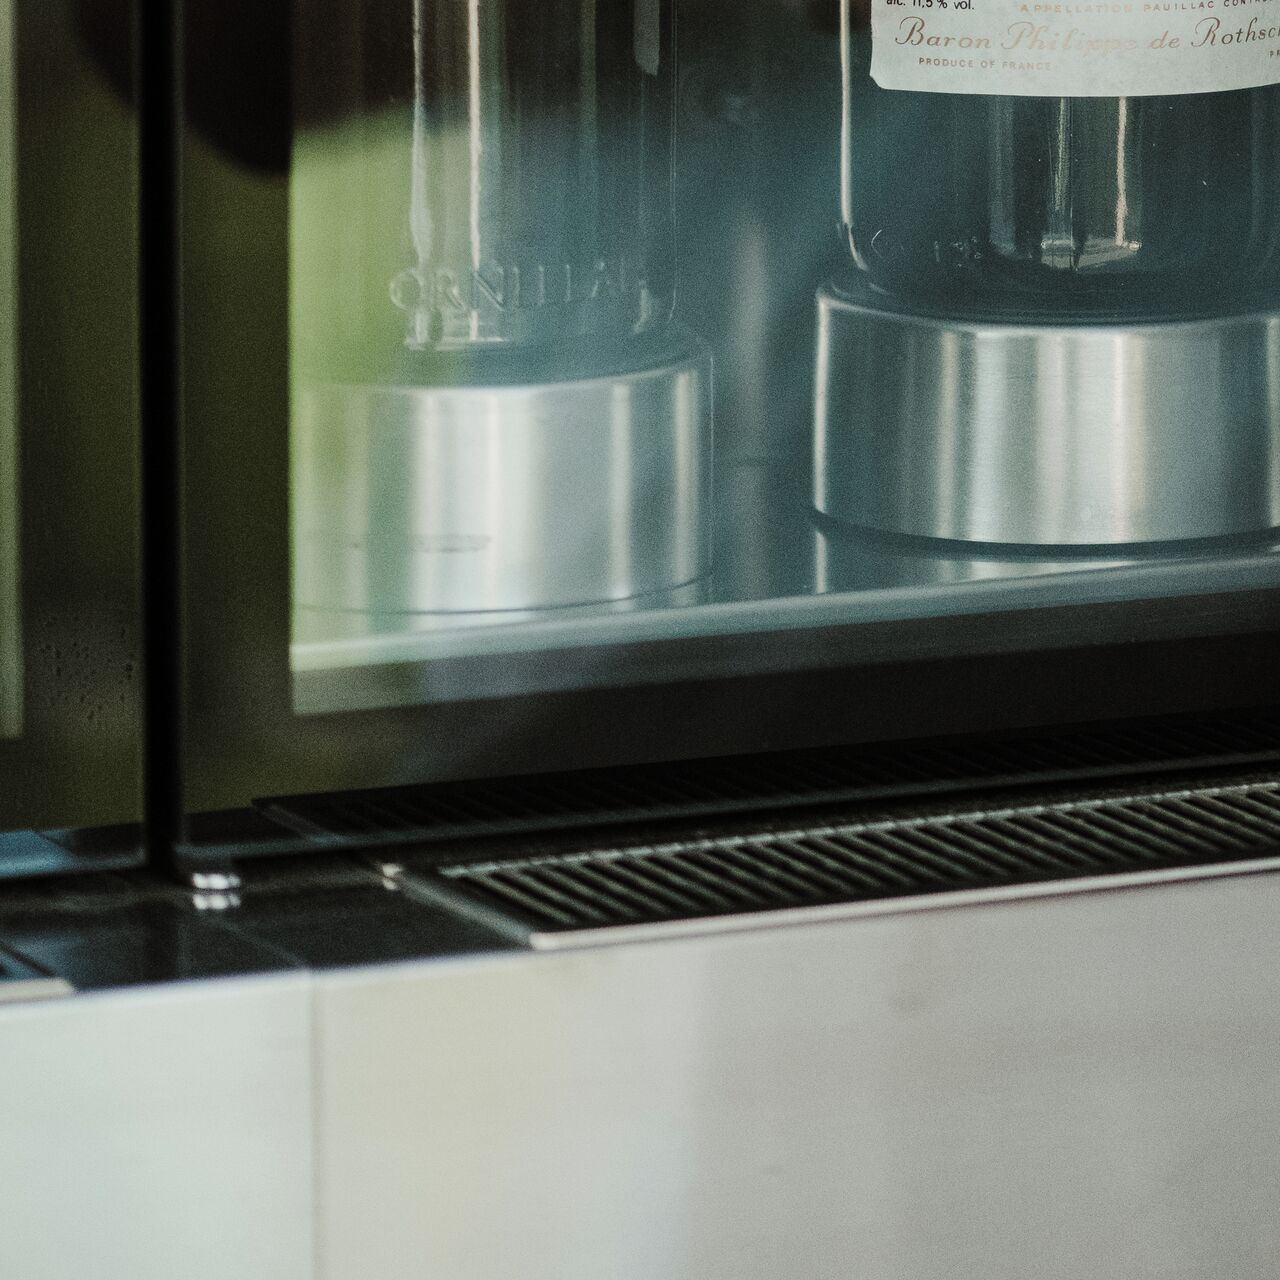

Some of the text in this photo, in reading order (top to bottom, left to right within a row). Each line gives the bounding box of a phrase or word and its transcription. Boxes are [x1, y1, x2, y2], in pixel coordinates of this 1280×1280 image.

[1143, 0, 1215, 12] PAUILLAC
[895, 15, 991, 46] Baron
[1149, 30, 1181, 51] de
[918, 57, 975, 69] PRODUCE
[980, 60, 994, 69] OF
